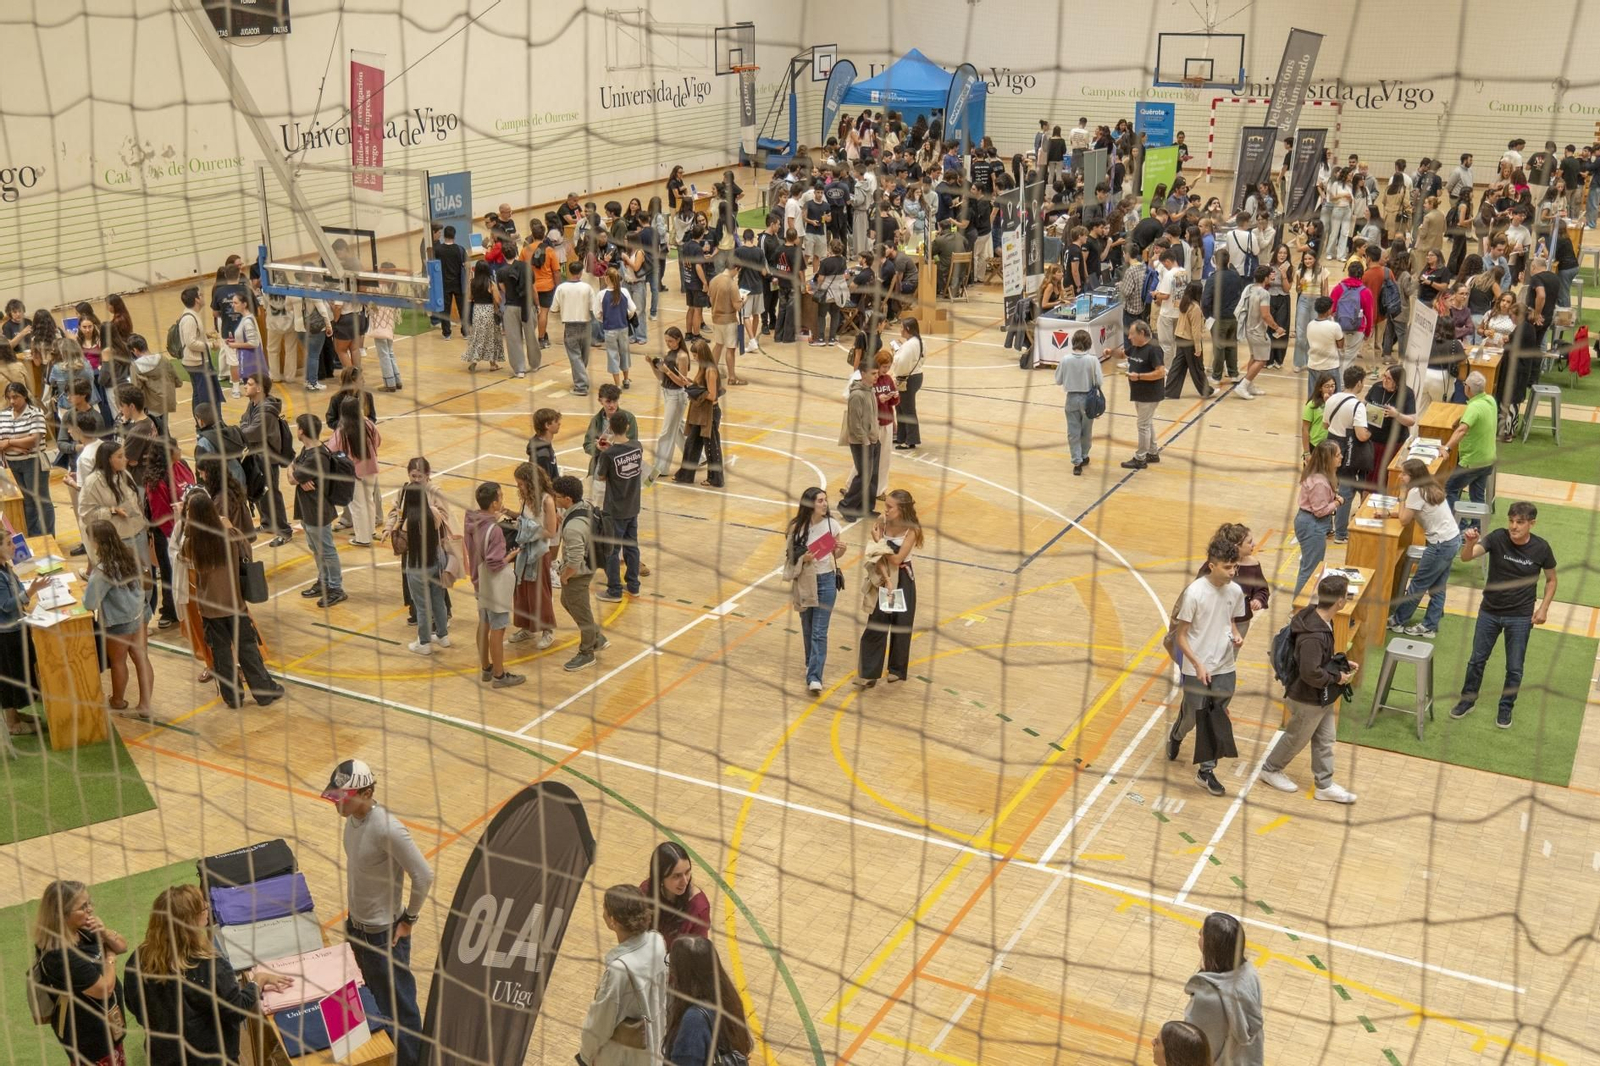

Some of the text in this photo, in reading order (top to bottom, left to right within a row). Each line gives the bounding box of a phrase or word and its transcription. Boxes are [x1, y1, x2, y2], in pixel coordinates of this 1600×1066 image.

[240, 27, 260, 36] JUGADOR
[989, 67, 1036, 95] Vigo
[1081, 86, 1126, 100] Campus
[1129, 88, 1142, 98] de
[1267, 59, 1295, 128] Delegacións
[1278, 54, 1311, 132] de Alumnado
[1489, 100, 1543, 115] Campus
[1547, 102, 1564, 114] de
[495, 111, 580, 133] Campus de Ourense
[189, 155, 246, 173] Ourense
[434, 194, 463, 212] GUAS
[457, 893, 565, 973] OLA!
